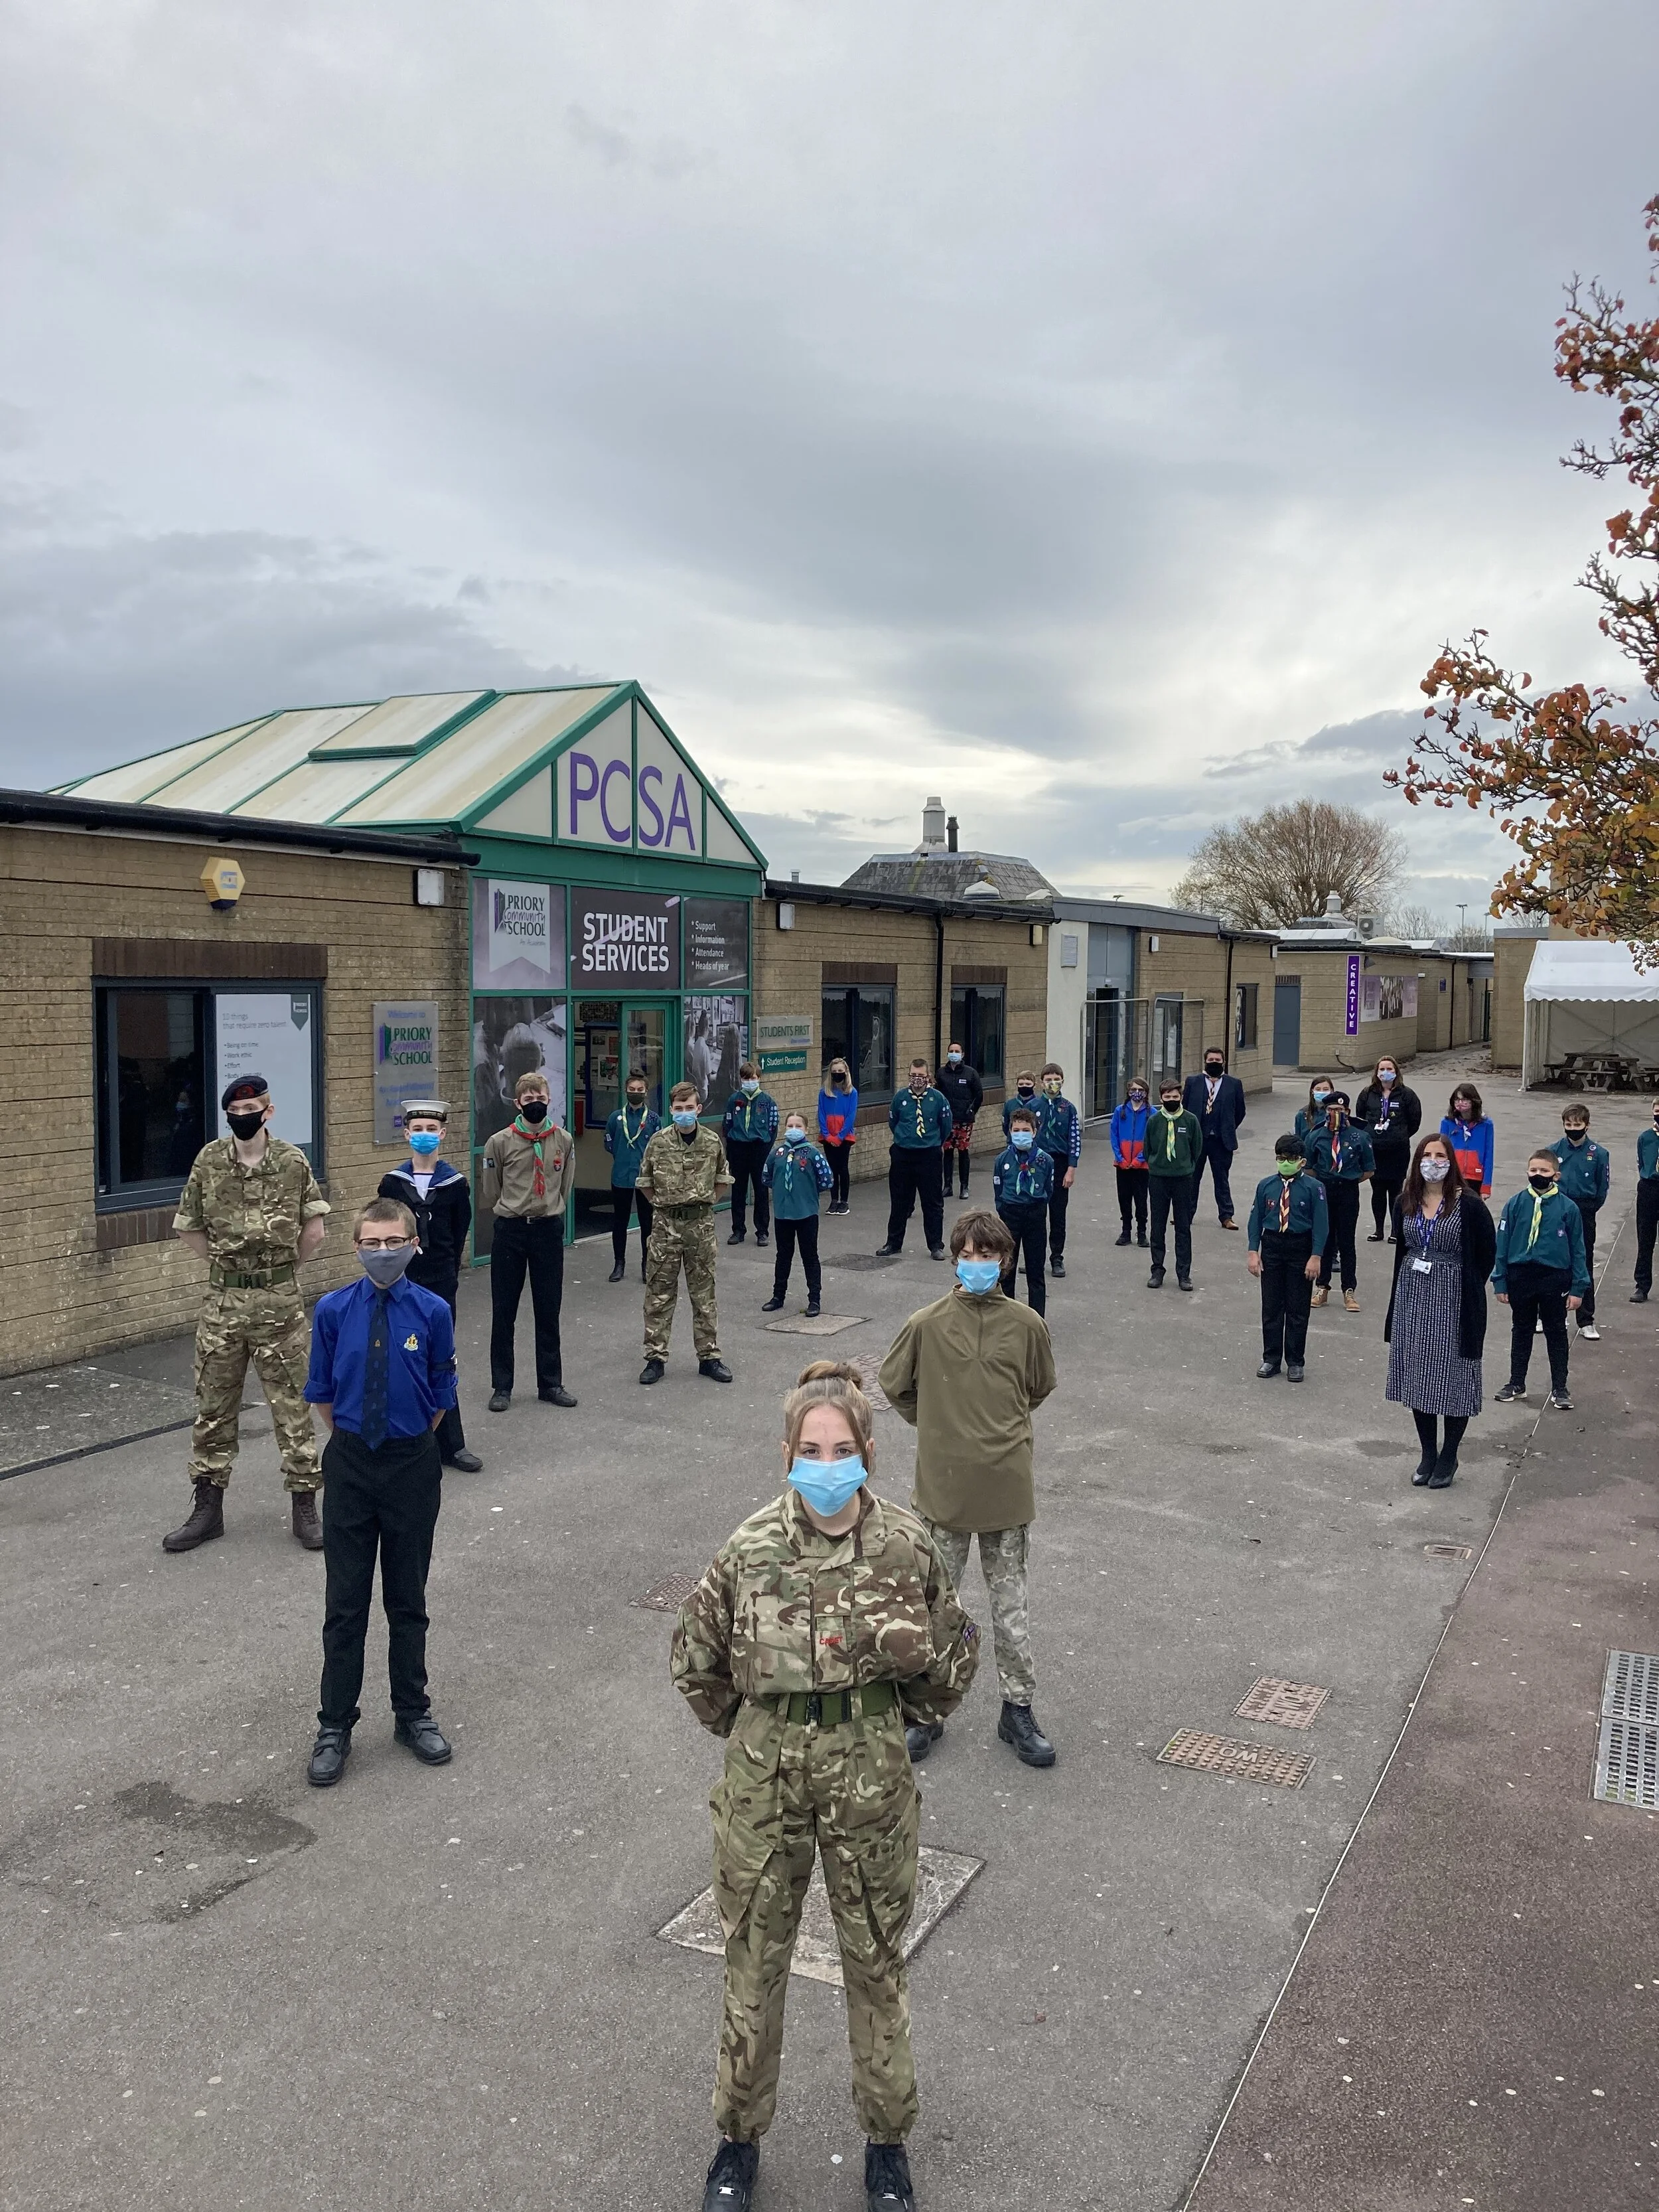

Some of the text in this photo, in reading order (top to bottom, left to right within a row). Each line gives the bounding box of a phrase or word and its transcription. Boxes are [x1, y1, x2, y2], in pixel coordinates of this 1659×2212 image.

[570, 751, 695, 850] PCSA
[508, 895, 545, 911] PRIORY
[508, 921, 545, 936] SCHOOL
[583, 912, 668, 942] STUDENT
[695, 921, 716, 932] Support
[695, 934, 725, 944] Information
[582, 943, 670, 972] SERVICES
[695, 947, 724, 957] Attendance
[695, 960, 730, 972] Heads of year
[394, 1027, 432, 1041] PRIORY
[760, 1025, 810, 1037] STUDENTS FIRST
[393, 1051, 433, 1065] SCHOOL
[766, 1056, 806, 1066] Student Reception
